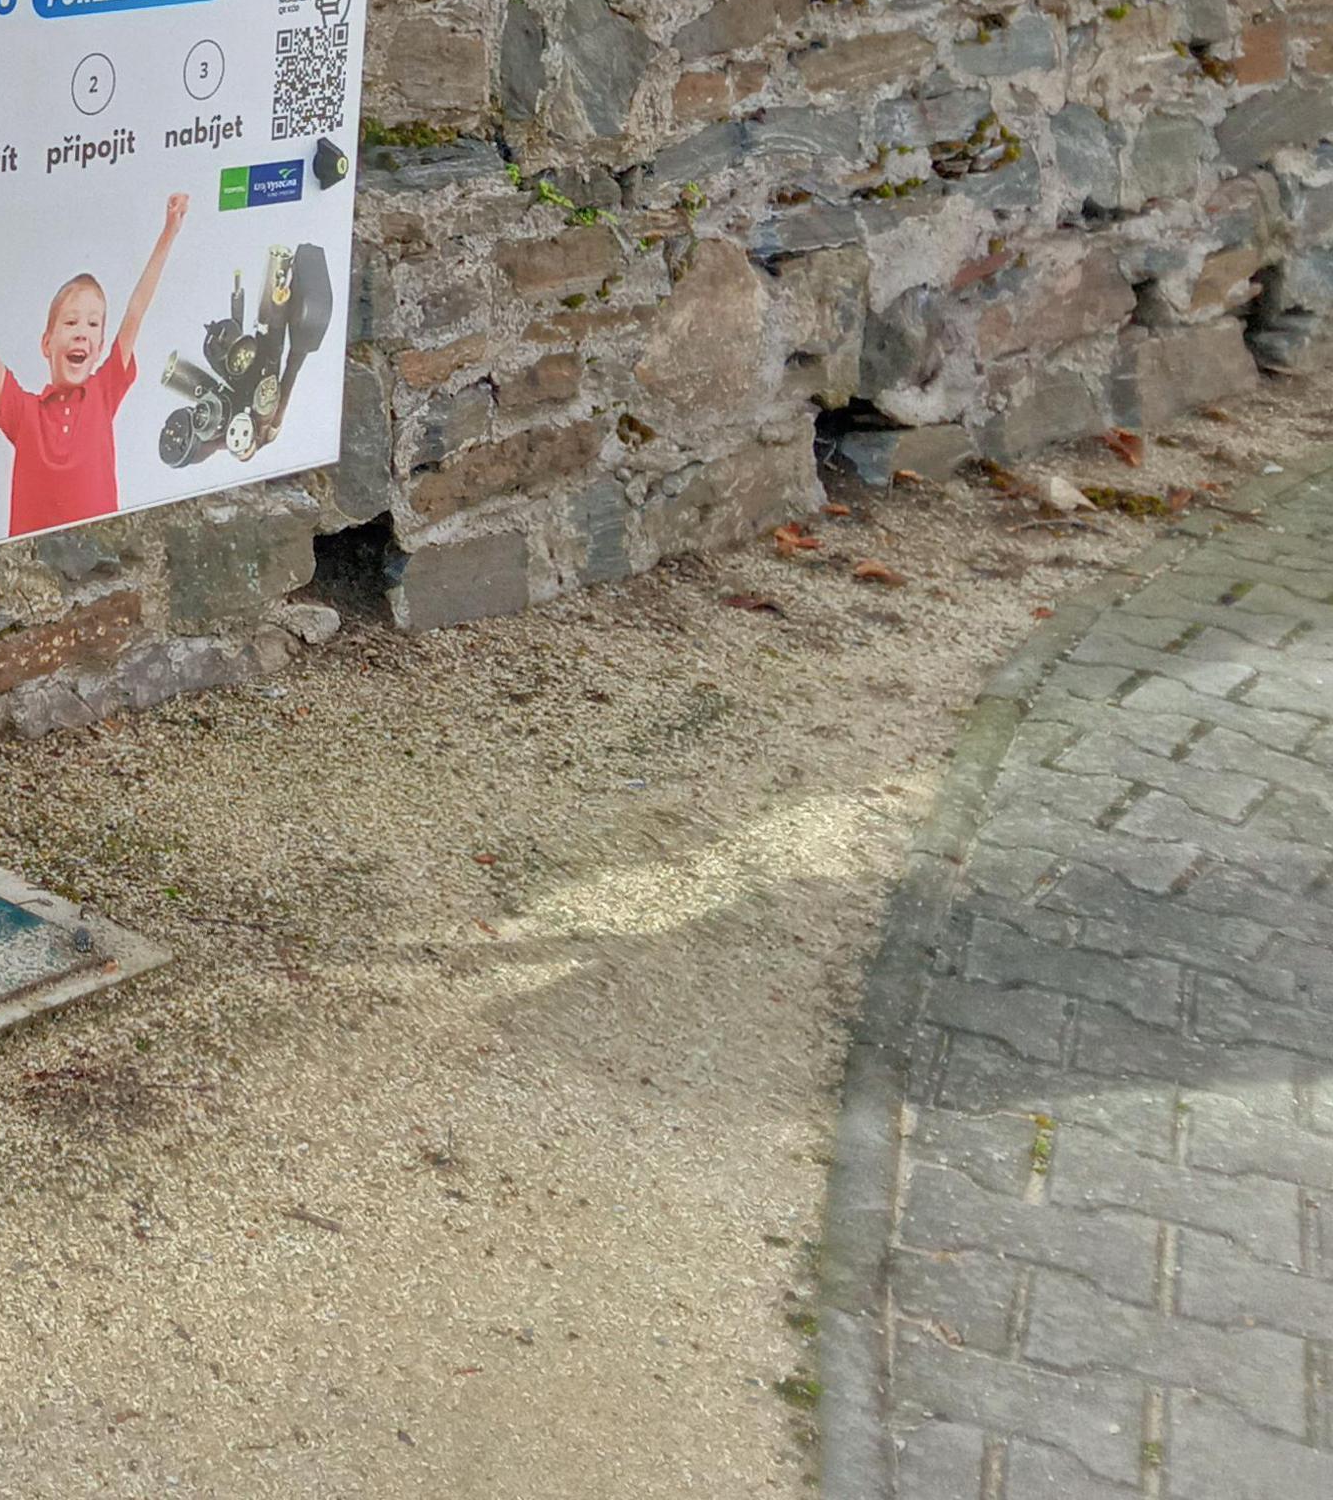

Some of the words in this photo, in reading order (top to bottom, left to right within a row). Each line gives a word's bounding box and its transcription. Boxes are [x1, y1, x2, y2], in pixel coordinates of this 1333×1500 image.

[199, 62, 209, 79] 3
[89, 75, 98, 94] 2
[165, 114, 243, 149] nabíjet
[46, 128, 136, 174] připojit
